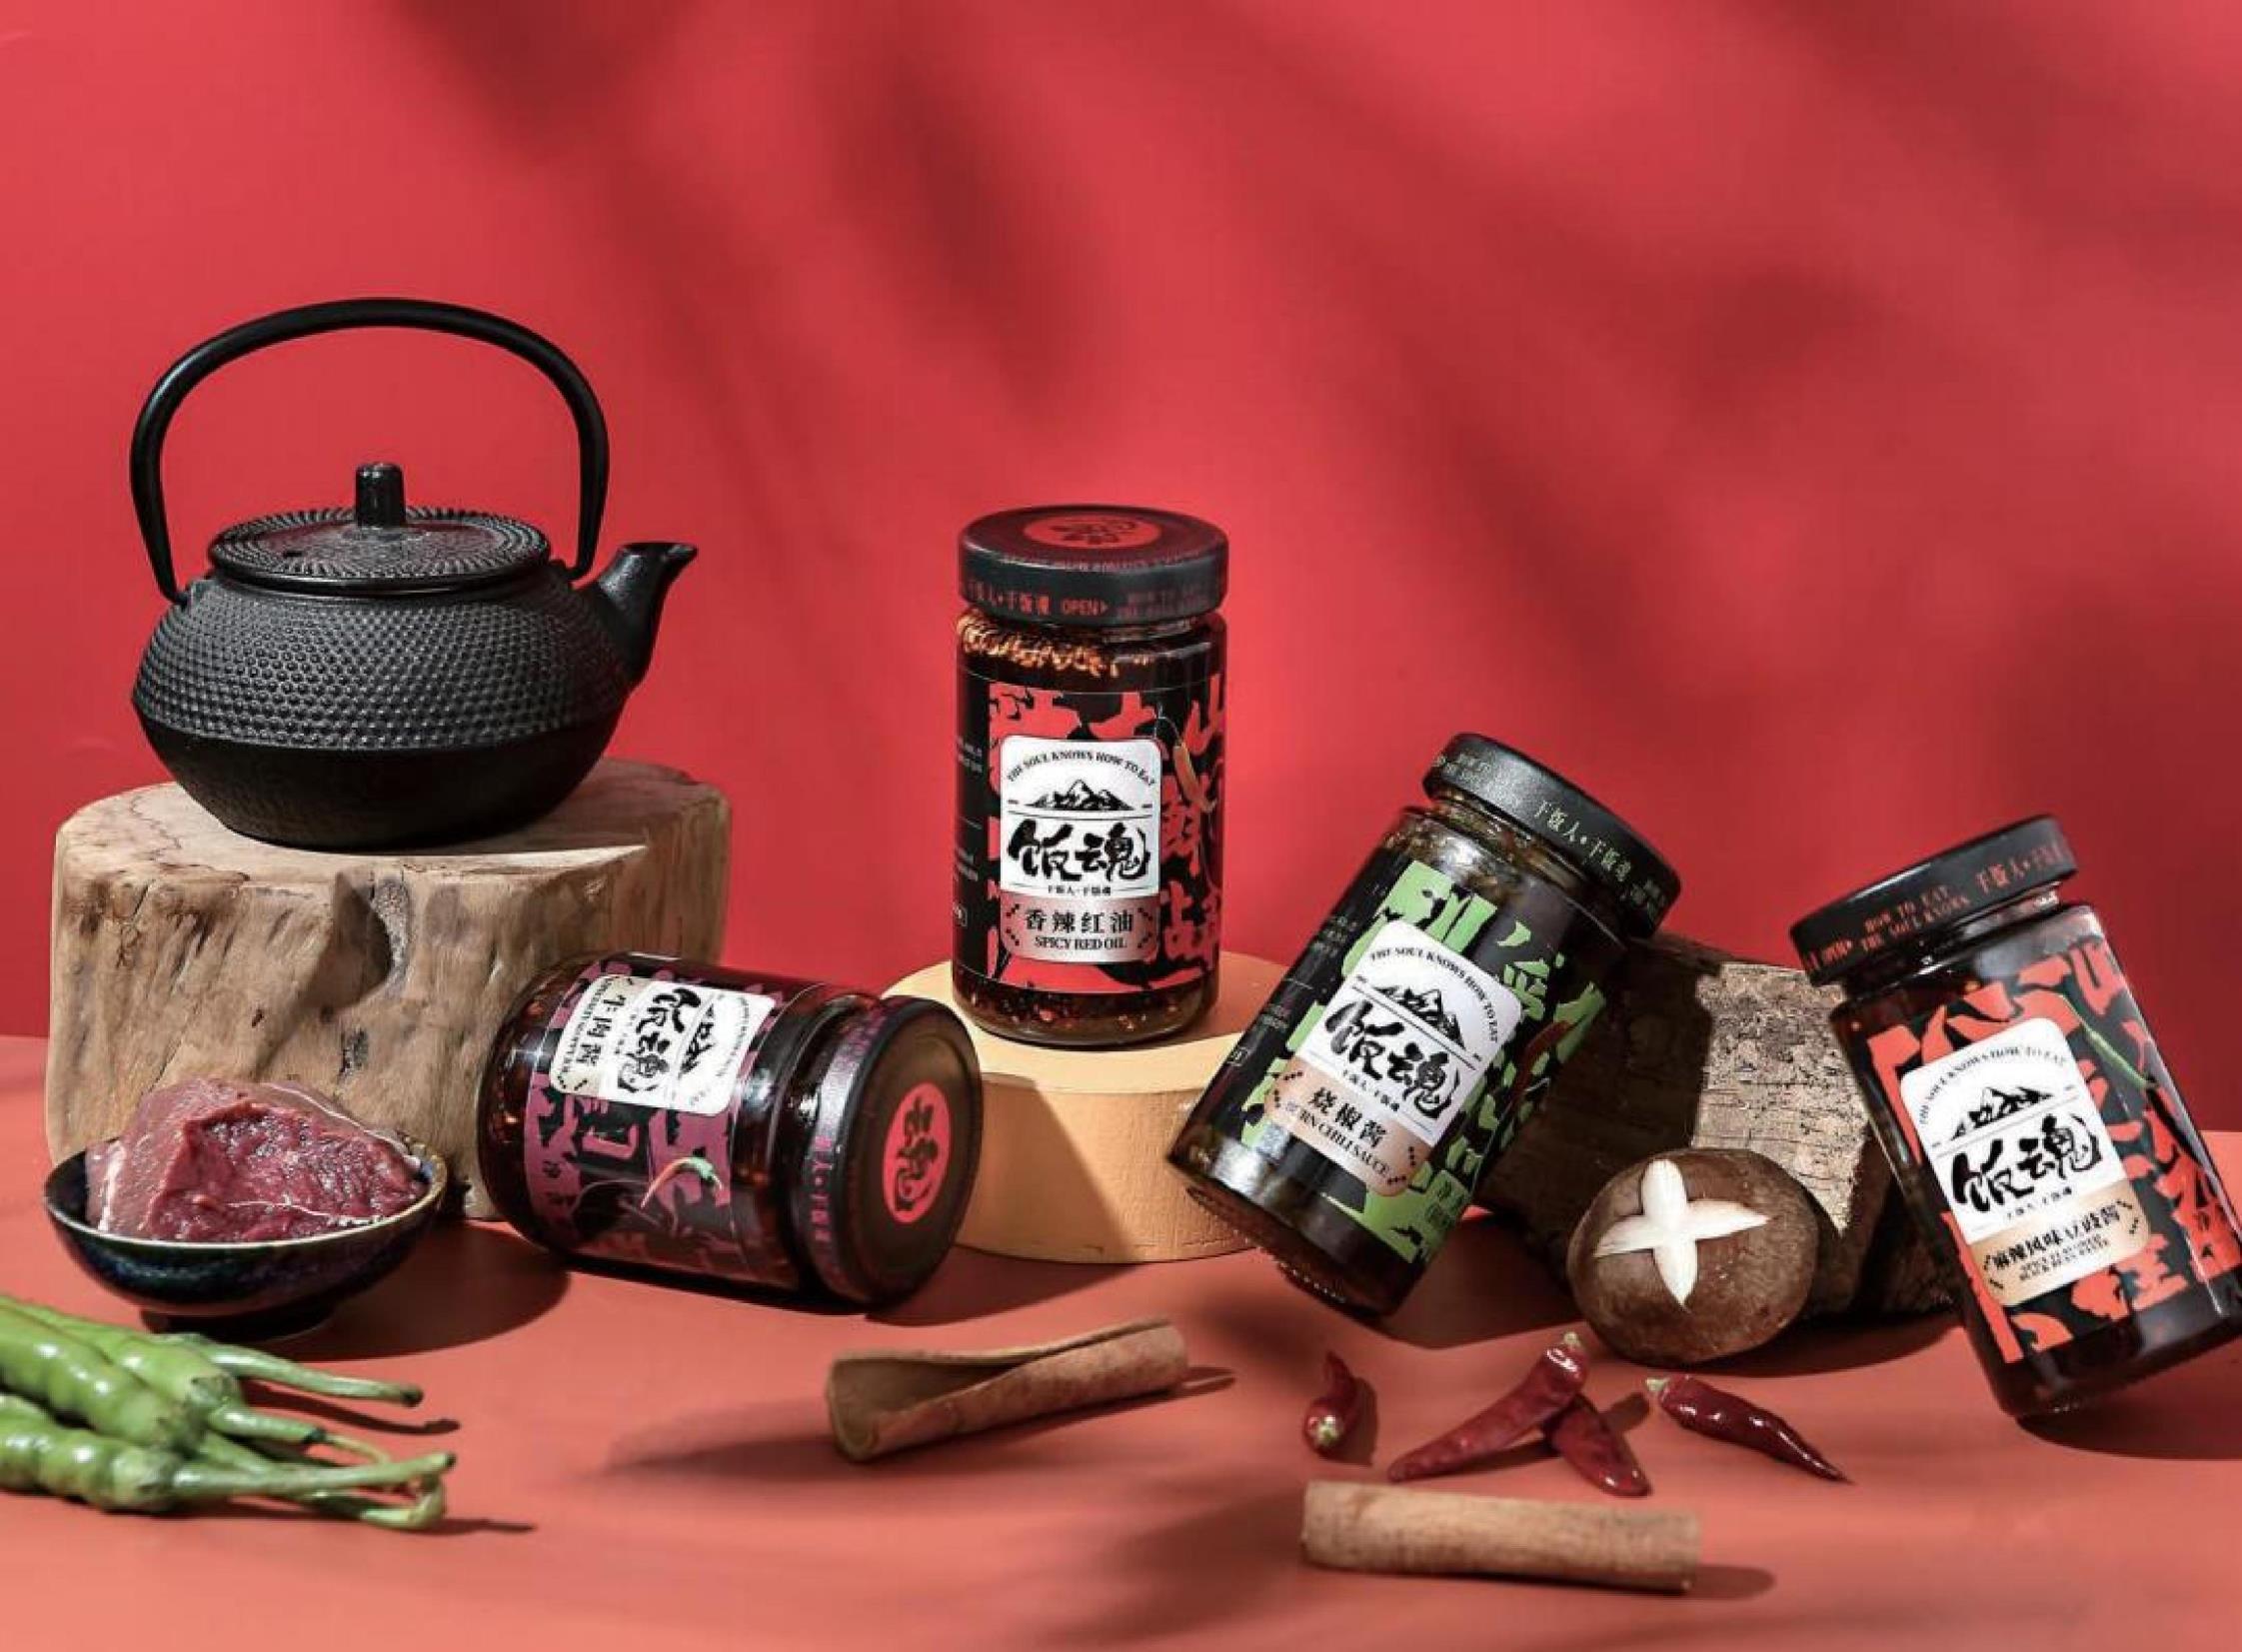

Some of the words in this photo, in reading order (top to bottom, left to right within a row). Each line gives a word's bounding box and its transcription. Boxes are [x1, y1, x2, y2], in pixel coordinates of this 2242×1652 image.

[1062, 599, 1098, 616] OPEN
[1096, 752, 1123, 767] HOW
[1007, 819, 1151, 882] 饭魂
[1026, 907, 1134, 933] 香辣红油
[1035, 936, 1071, 949] SPICY
[1075, 938, 1103, 950] RED
[1104, 938, 1127, 949] OIL
[617, 987, 702, 1093] 饭魂
[1325, 1000, 1461, 1120] 饭魂
[1307, 1086, 1386, 1147] 烧椒酱
[1343, 1139, 1390, 1177] SAUCE
[1952, 1113, 2103, 1213] 饭魂
